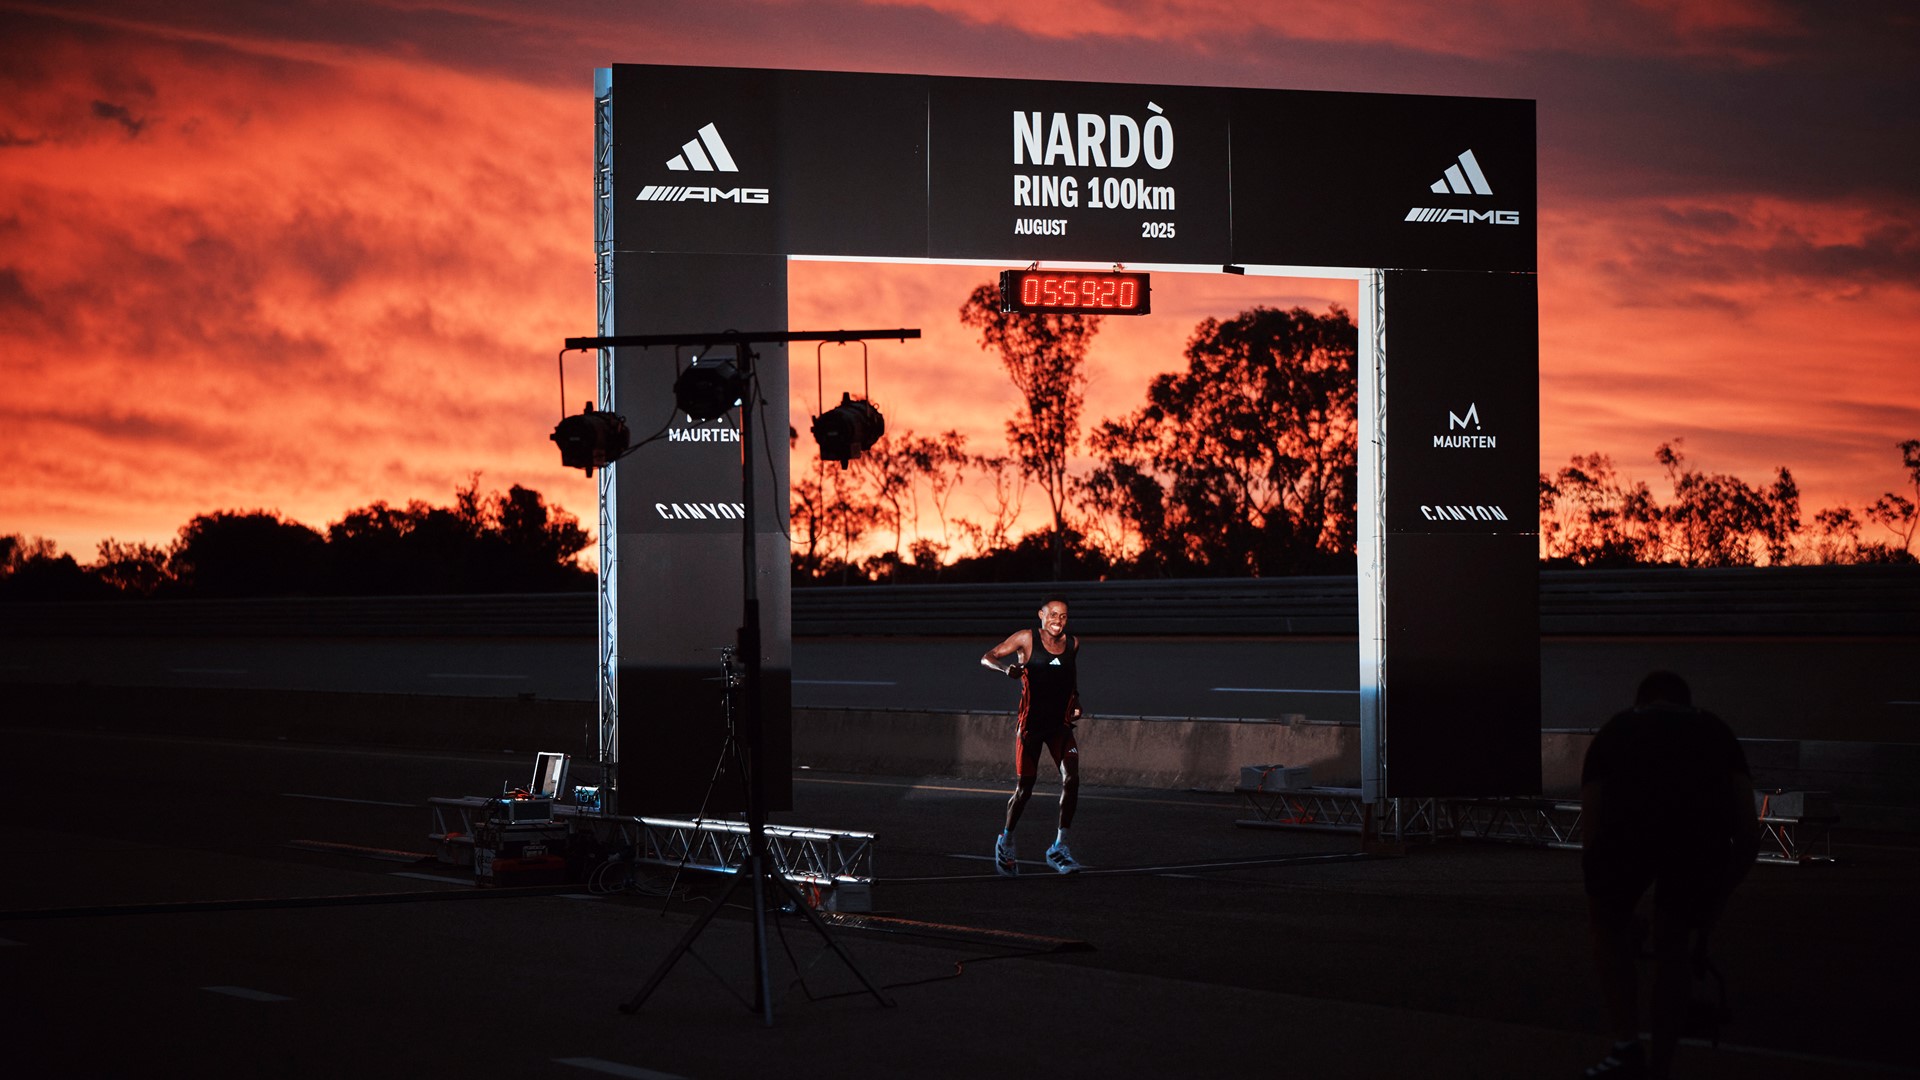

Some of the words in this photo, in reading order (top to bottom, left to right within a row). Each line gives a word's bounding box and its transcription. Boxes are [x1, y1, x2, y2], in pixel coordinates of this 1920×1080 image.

[1013, 101, 1174, 170] NARDÒ
[1013, 174, 1078, 208] RING
[1087, 177, 1176, 212] 100km
[1014, 218, 1068, 236] AUGUST
[1141, 222, 1176, 239] 2025
[1022, 278, 1136, 308] 05:59:20
[668, 428, 741, 442] MAURTEN
[1433, 435, 1497, 449] MAURTEN
[1420, 505, 1509, 521] CANYON
